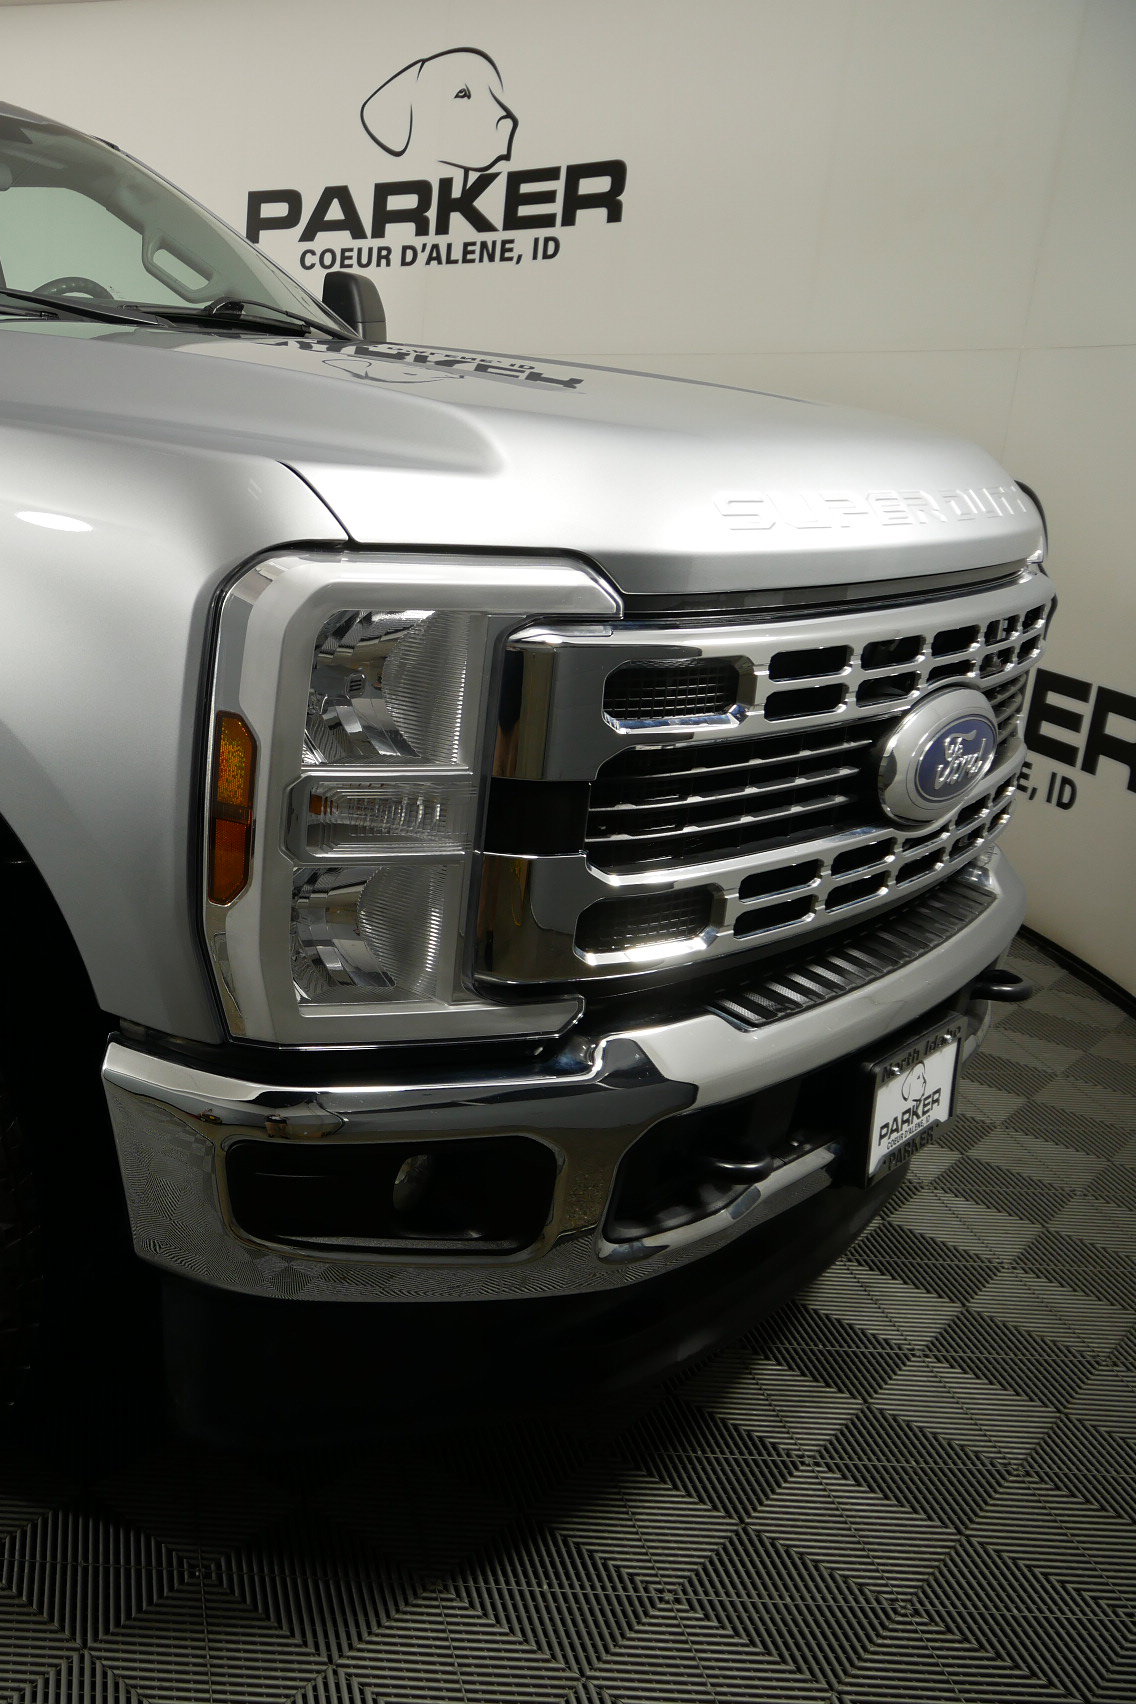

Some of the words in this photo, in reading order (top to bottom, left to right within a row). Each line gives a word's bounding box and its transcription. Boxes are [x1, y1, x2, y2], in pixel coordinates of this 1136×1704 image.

[246, 159, 627, 244] PARKER
[299, 246, 392, 270] COEUR
[400, 238, 523, 266] D'ALENE,
[532, 236, 561, 260] ID
[933, 729, 988, 790] Ford
[1046, 772, 1077, 811] ID
[878, 1088, 942, 1147] PARKER
[887, 1126, 934, 1171] PARKER
